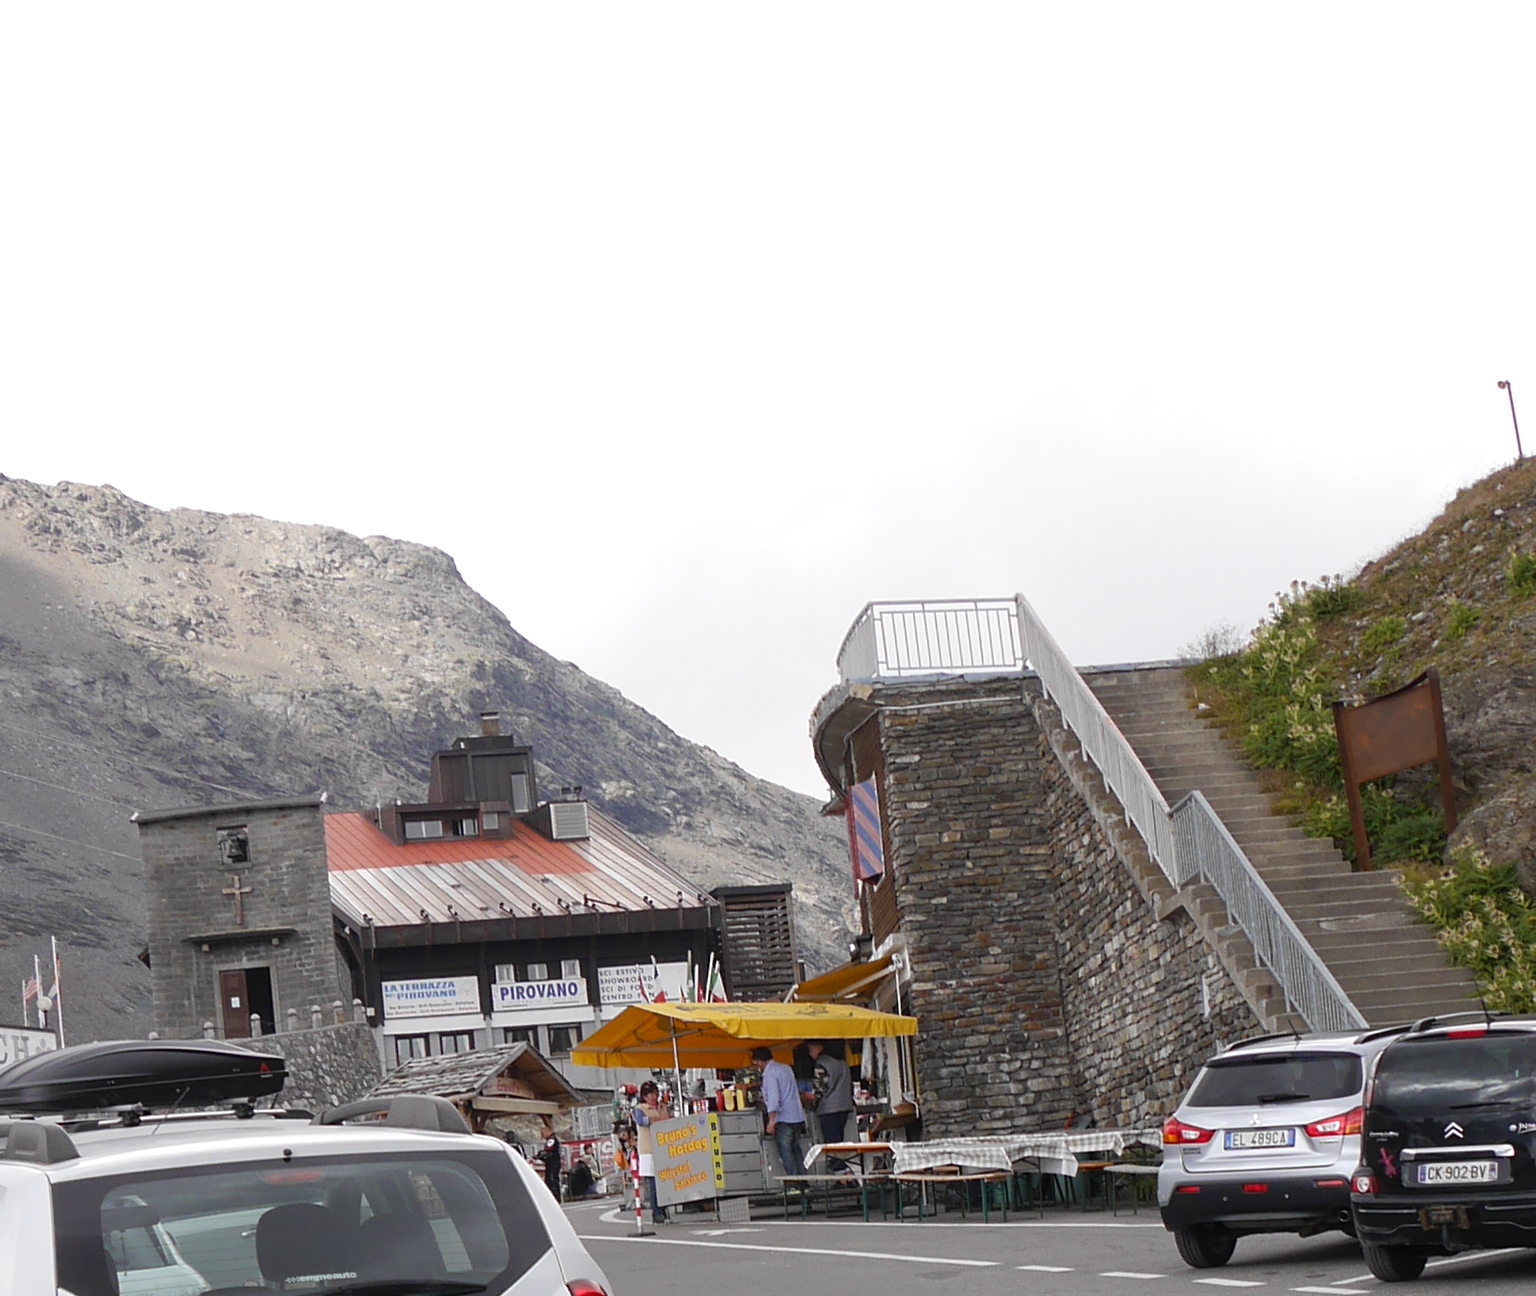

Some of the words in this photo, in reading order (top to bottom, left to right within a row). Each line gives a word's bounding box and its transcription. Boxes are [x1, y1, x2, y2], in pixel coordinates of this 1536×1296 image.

[600, 976, 653, 985] SNOWBORD
[500, 982, 578, 1001] PIROVANO
[1232, 1133, 1246, 1146] EL
[1250, 1132, 1286, 1145] 489CA
